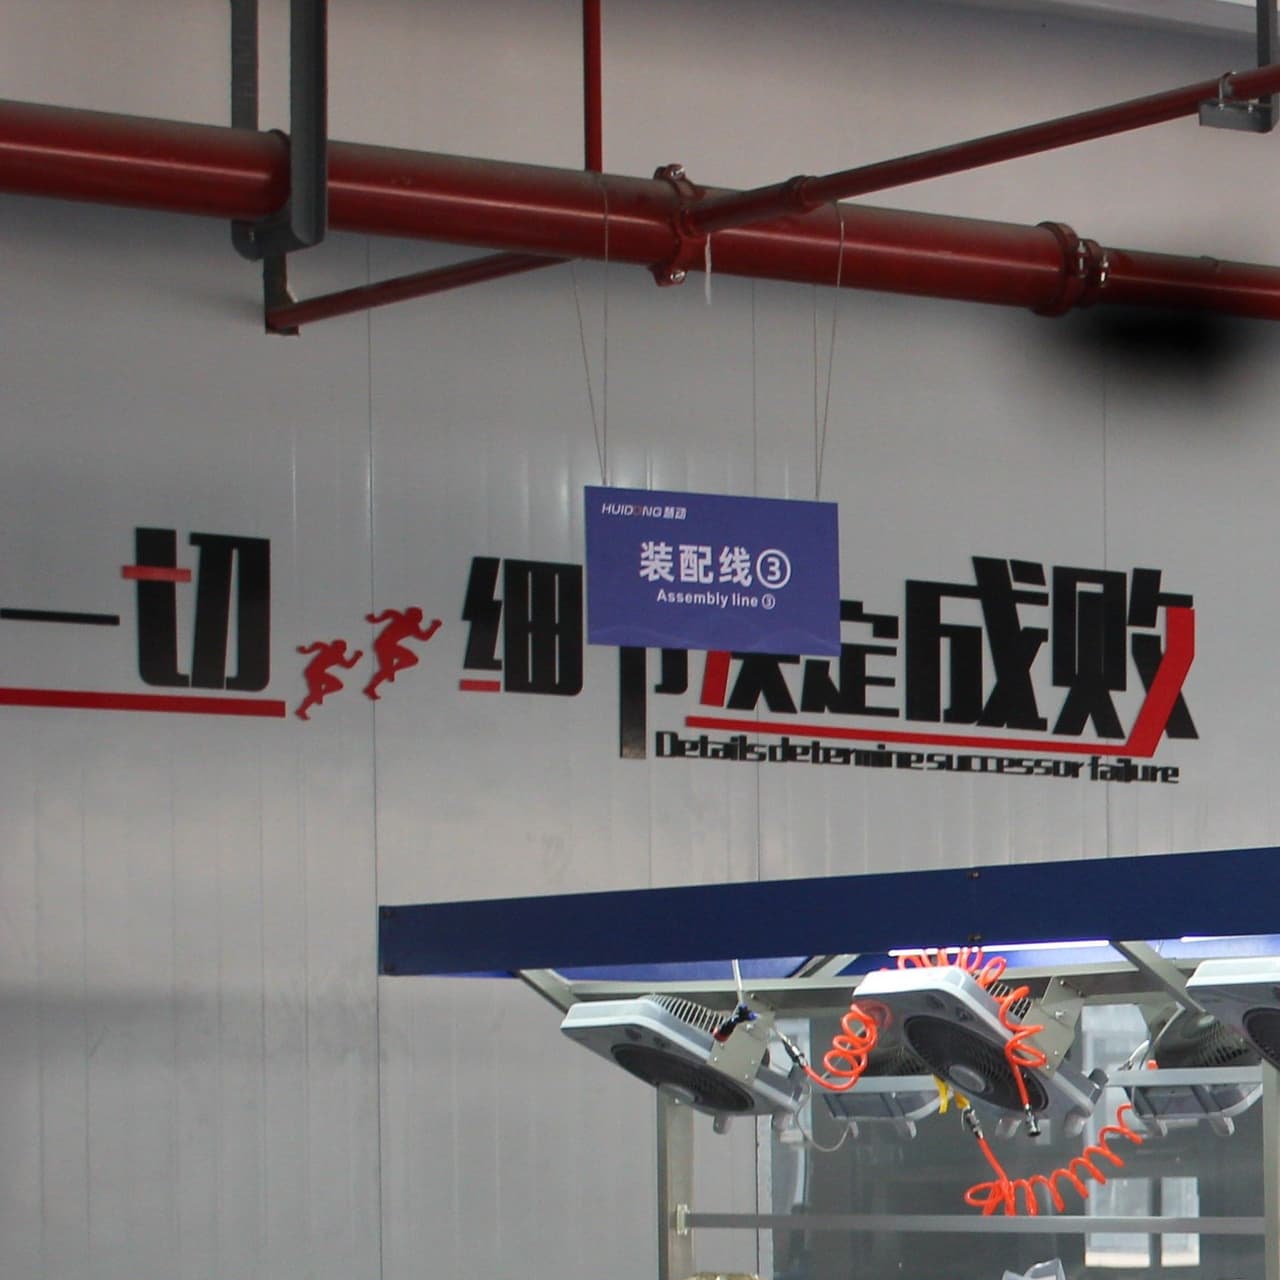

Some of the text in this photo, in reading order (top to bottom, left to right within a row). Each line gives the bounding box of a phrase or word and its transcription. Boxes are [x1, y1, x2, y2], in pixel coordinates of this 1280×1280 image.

[640, 541, 792, 590] 装配线③
[657, 589, 729, 609] Assembly
